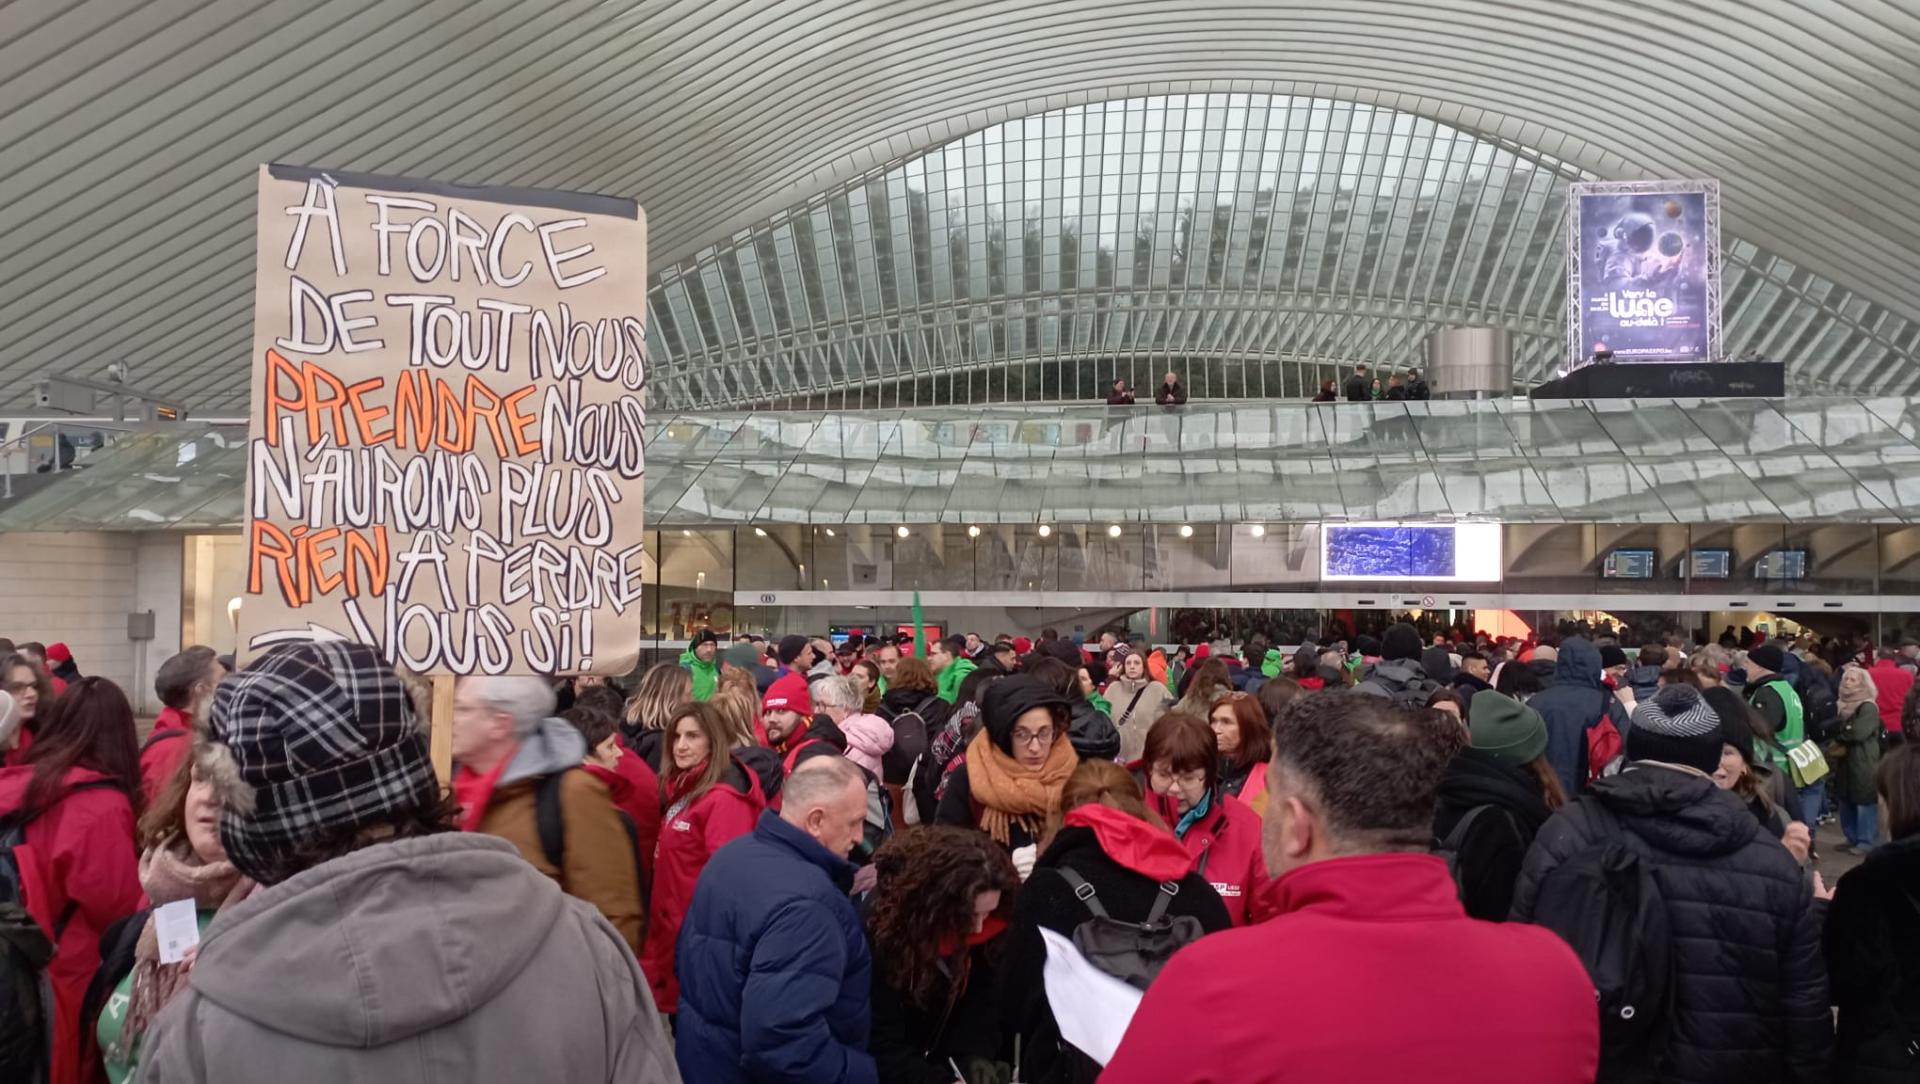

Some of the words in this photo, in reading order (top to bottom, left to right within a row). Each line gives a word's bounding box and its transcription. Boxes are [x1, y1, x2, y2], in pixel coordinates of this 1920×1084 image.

[285, 173, 347, 277] À
[365, 193, 607, 289] FORCE
[276, 275, 386, 354] DE
[386, 294, 532, 373] TOUT
[530, 303, 647, 389] NOUS
[264, 348, 542, 459] PRENDRE
[541, 379, 646, 478] NOUS
[500, 460, 622, 547] PLUS
[463, 530, 643, 617] PERDRE
[344, 582, 514, 676] VOUS
